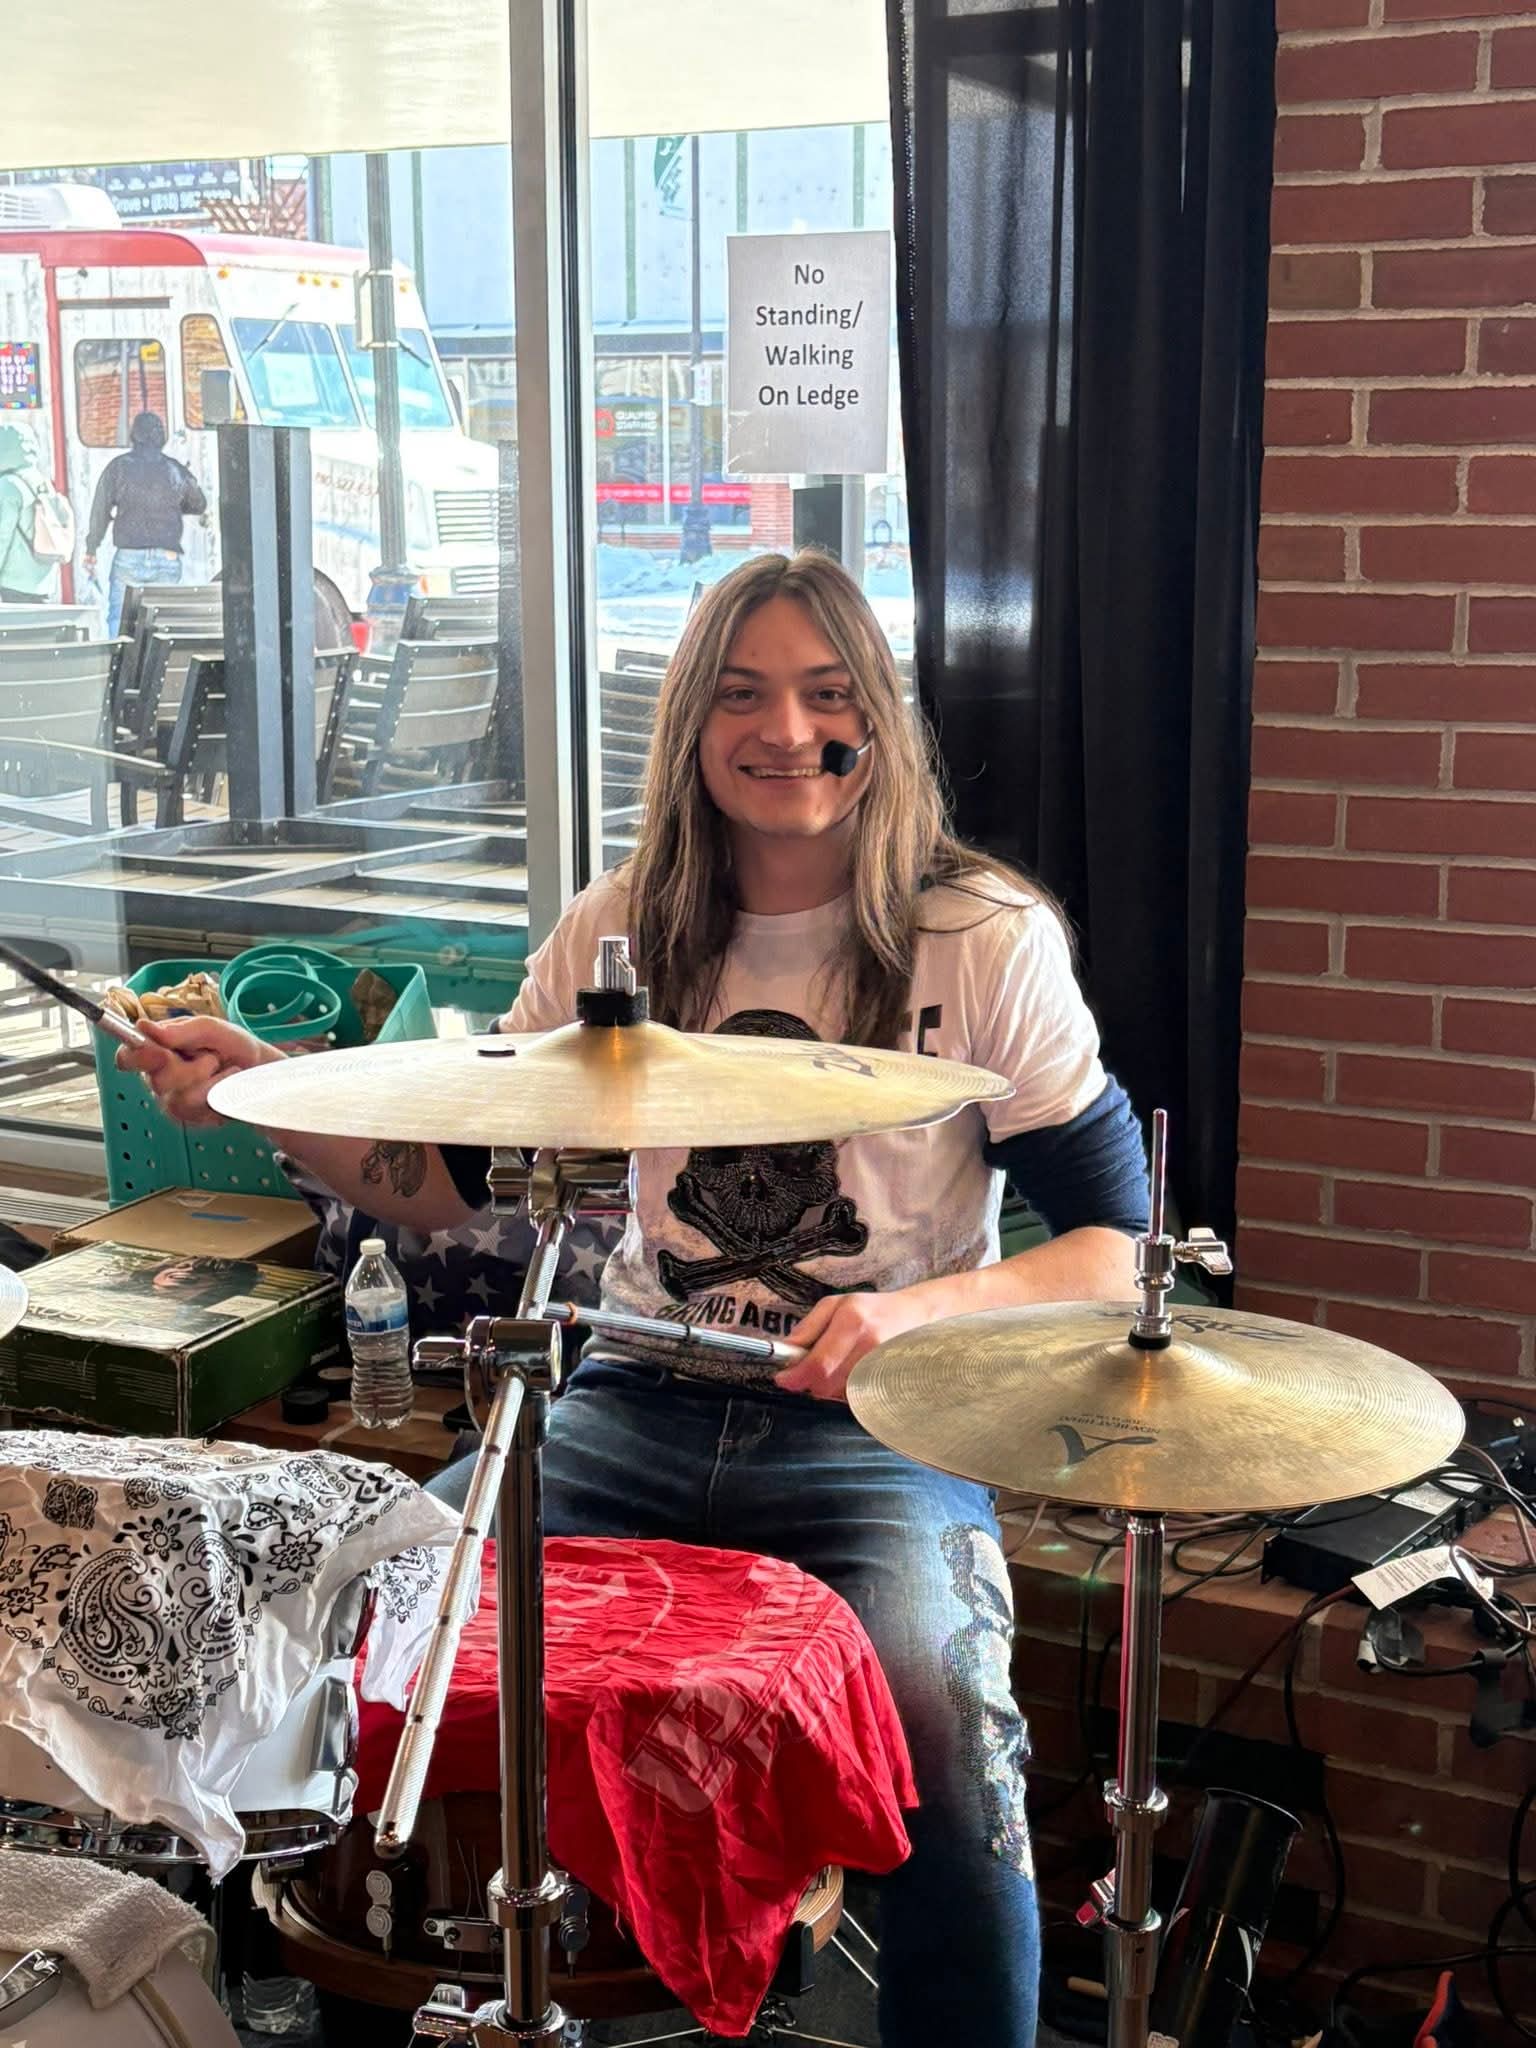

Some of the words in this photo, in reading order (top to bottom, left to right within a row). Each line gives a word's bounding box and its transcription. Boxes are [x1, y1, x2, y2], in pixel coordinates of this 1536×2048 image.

[794, 263, 825, 285] No
[755, 300, 864, 330] Standing/
[764, 343, 855, 370] Walking
[758, 385, 789, 406] On
[797, 383, 860, 410] Ledge
